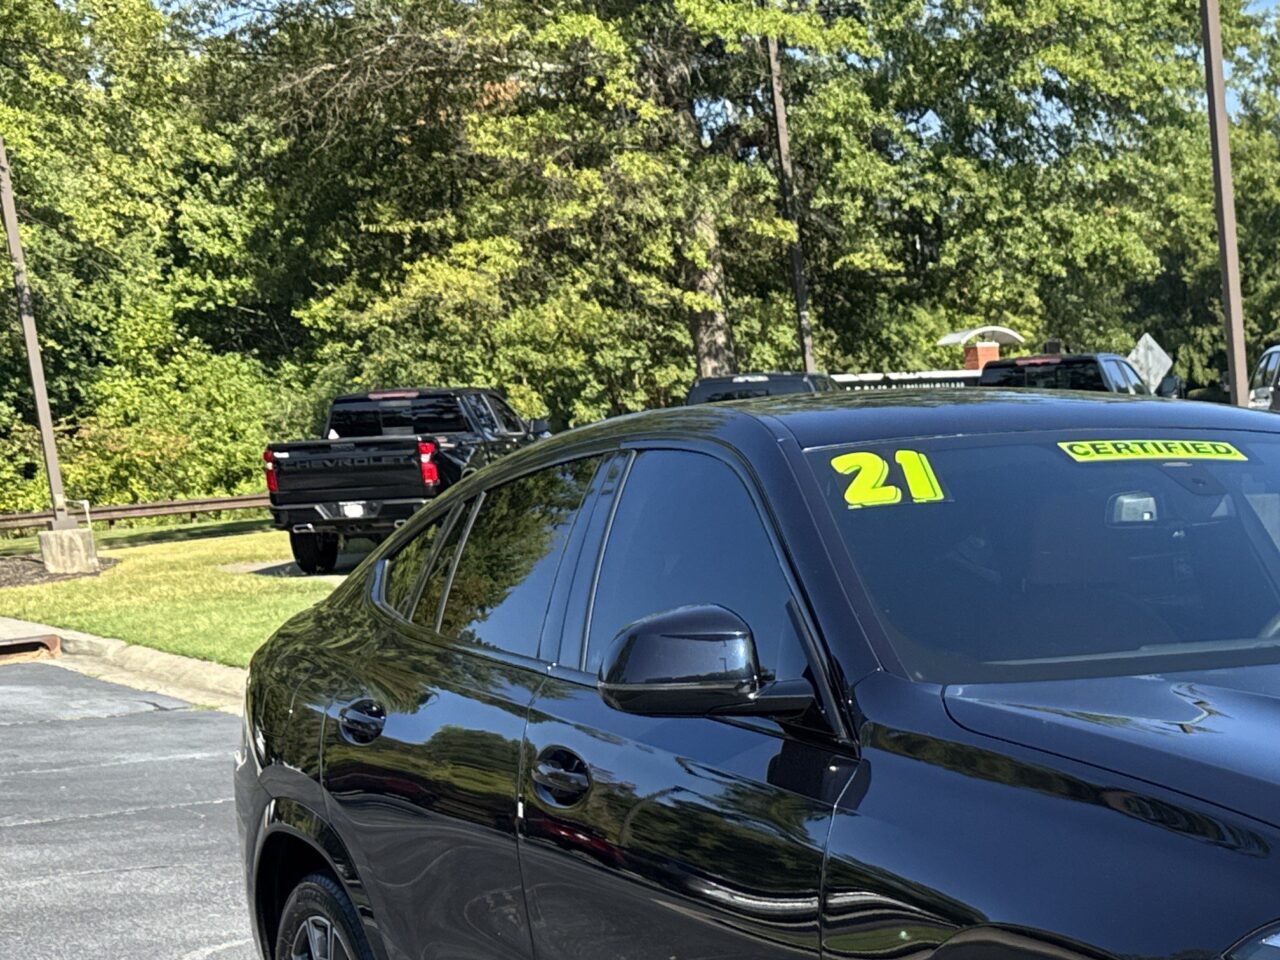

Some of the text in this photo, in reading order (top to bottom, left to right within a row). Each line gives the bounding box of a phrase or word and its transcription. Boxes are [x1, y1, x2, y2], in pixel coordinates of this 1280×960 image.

[1067, 441, 1235, 457] CERTIFIED
[282, 457, 408, 470] CHEVROLET
[831, 449, 945, 510] 21
